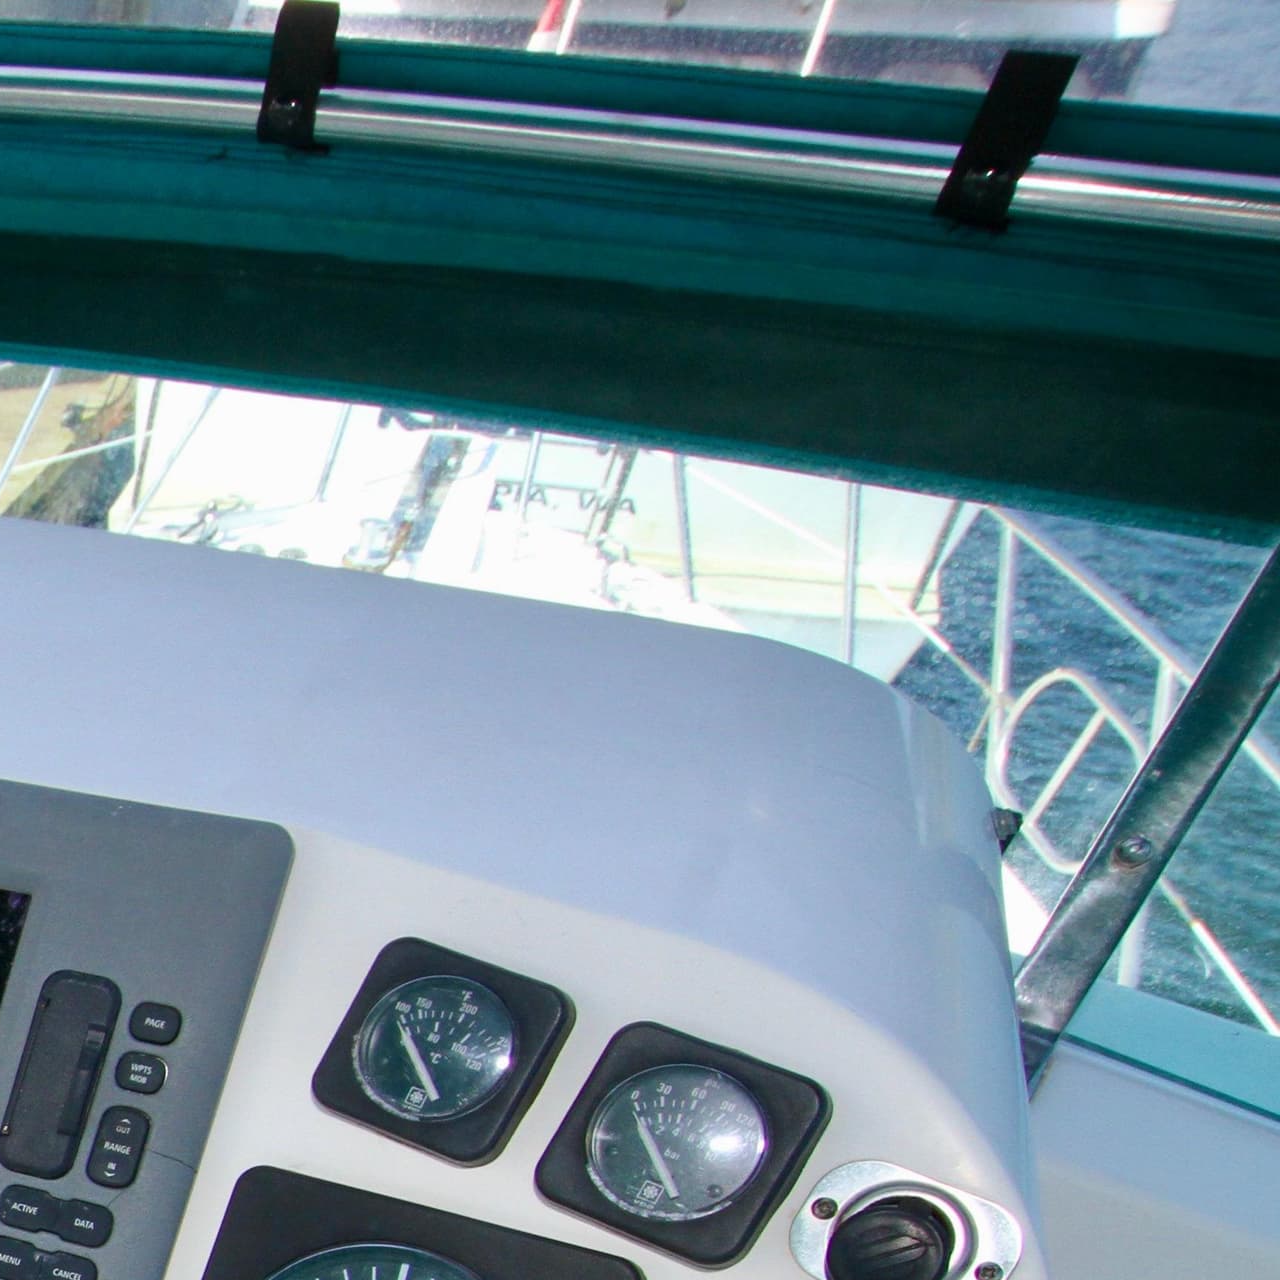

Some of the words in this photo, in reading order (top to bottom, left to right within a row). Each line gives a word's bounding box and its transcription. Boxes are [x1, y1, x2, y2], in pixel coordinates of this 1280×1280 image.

[394, 1000, 413, 1014] 100
[416, 996, 434, 1010] 150
[458, 1002, 480, 1016] 200
[144, 1016, 168, 1030] PAGE
[450, 1041, 468, 1055] 100
[130, 1062, 154, 1076] WPTS
[465, 1058, 483, 1072] 120
[129, 1073, 148, 1085] MOB
[630, 1089, 641, 1100] 0
[655, 1082, 674, 1095] 30
[691, 1087, 709, 1100] 60
[719, 1101, 737, 1113] 90
[115, 1124, 132, 1135] OUT
[655, 1126, 666, 1136] 2
[671, 1127, 681, 1138] 4
[103, 1141, 133, 1156] RANGE
[107, 1161, 118, 1171] IN
[11, 1202, 40, 1216] ACTIVE
[73, 1217, 95, 1231] DATA
